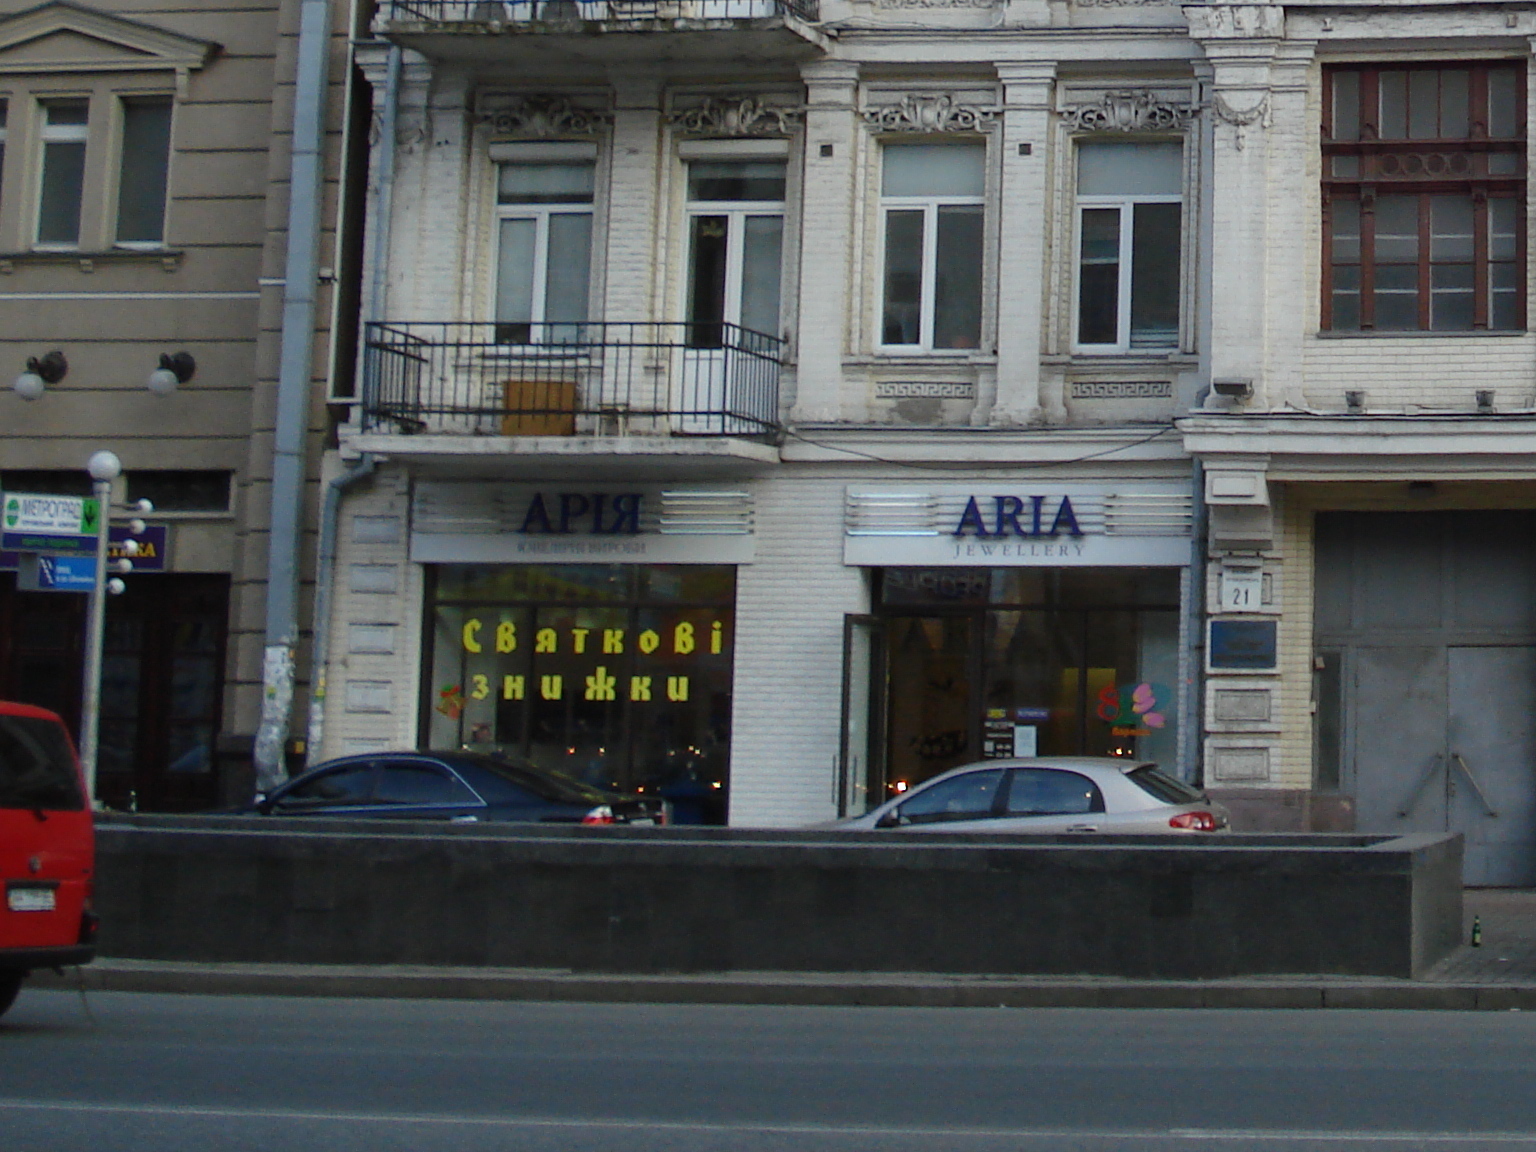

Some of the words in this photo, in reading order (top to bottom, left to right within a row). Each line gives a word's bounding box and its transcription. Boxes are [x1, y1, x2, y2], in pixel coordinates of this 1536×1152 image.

[516, 492, 644, 534] АРІЯ
[951, 495, 1084, 536] ARIA
[953, 545, 1085, 559] JEWELLERY
[1233, 588, 1249, 605] 21
